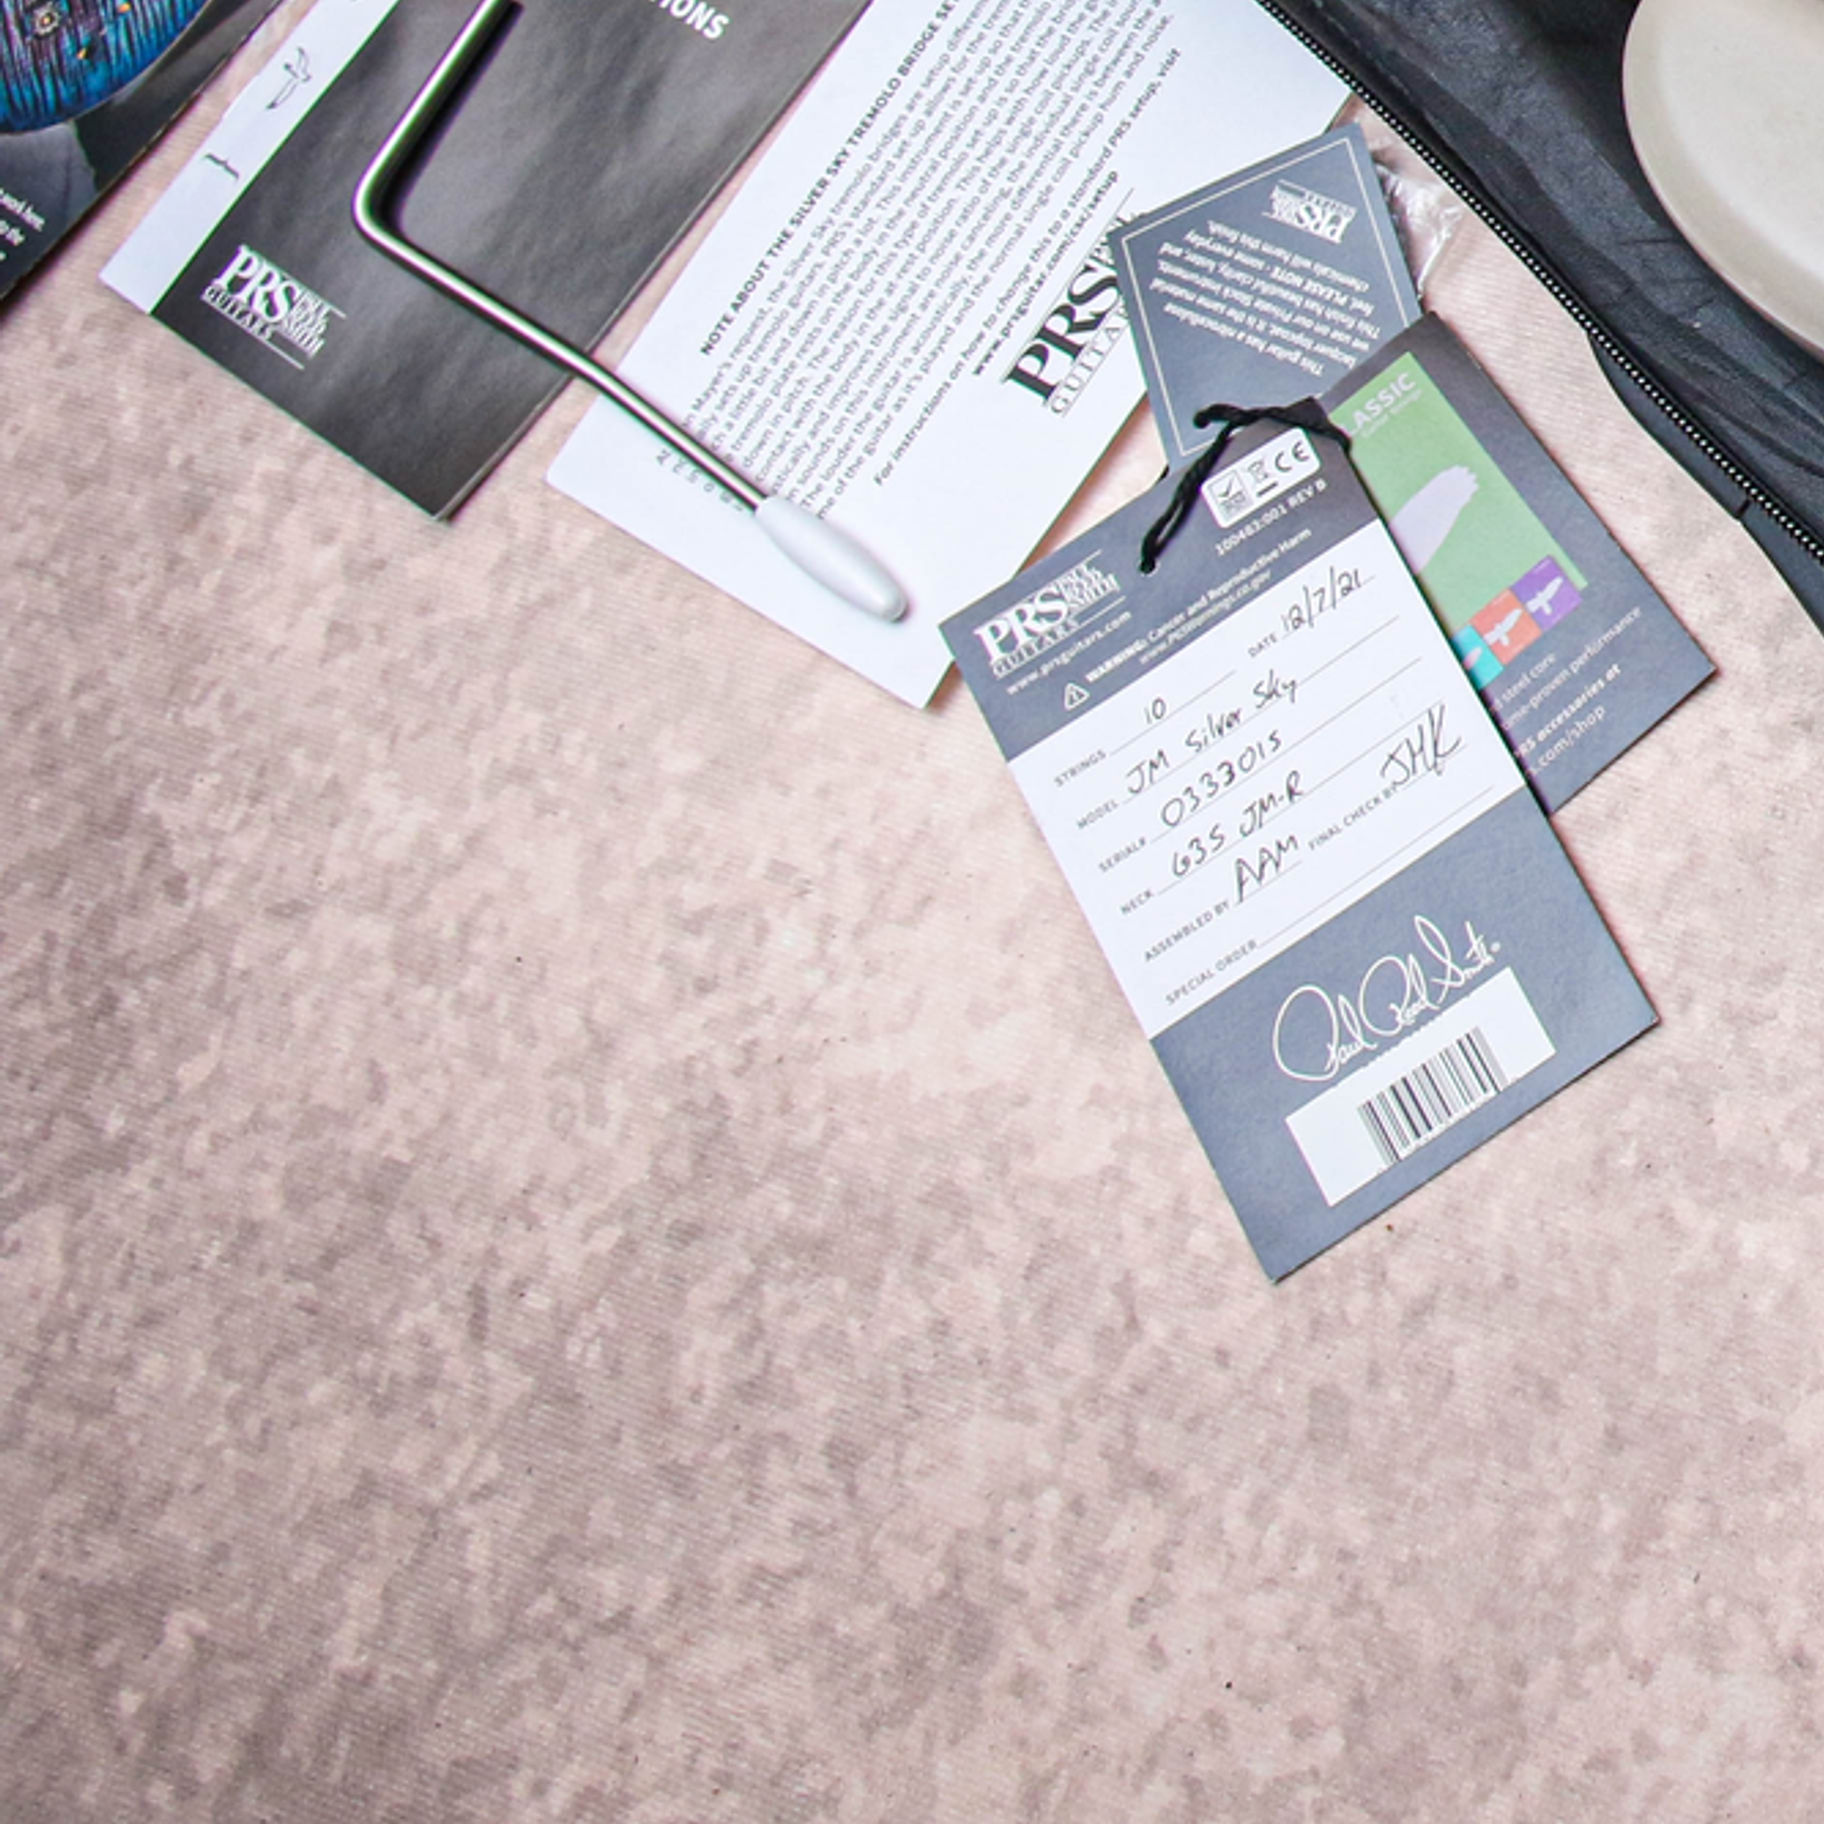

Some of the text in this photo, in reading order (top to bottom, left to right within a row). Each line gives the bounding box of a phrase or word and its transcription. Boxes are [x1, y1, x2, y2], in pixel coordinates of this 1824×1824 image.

[700, 313, 733, 355] NOTE
[730, 259, 769, 312] ABOUT
[766, 229, 793, 257] THE
[789, 177, 829, 226] SILVER
[825, 147, 849, 176] SKY
[846, 77, 901, 145] TREMOLO
[897, 22, 939, 76] BRIDGE
[691, 361, 731, 411] Mayer's
[728, 307, 773, 360] request,
[766, 279, 788, 303] the
[782, 241, 814, 278] Silver
[810, 215, 835, 240] Sky
[829, 163, 872, 215] tremolo
[866, 114, 908, 162] bridges
[905, 90, 923, 112] are
[920, 52, 950, 89] setup
[1290, 201, 1353, 245] PRS
[212, 245, 302, 323] PRS
[873, 48, 1180, 486] For instructions on how to change this to a standard PRS setup, visit
[1269, 266, 1304, 286] NOTE
[1302, 278, 1348, 305] PLEASE
[1006, 266, 1122, 406] PRS
[973, 584, 1068, 664] PRS
[1281, 566, 1365, 633] 12/7/21
[1006, 609, 1132, 696] www.prsguitars.com
[1247, 632, 1277, 658] DATE
[1125, 668, 1297, 795] JM Silver Sky
[1143, 696, 1171, 724] 10
[1053, 749, 1106, 787] STRINGS
[1160, 730, 1285, 828] 0333015
[1076, 799, 1118, 829] MODEL
[1307, 824, 1342, 850] FINAL
[1342, 795, 1382, 826] CHECK
[1098, 836, 1146, 872] SERIAL#
[1120, 889, 1154, 914] NECK
[1144, 899, 1229, 961] ASSEMBLED BY
[1165, 939, 1260, 1005] SPECIAL ORDER
